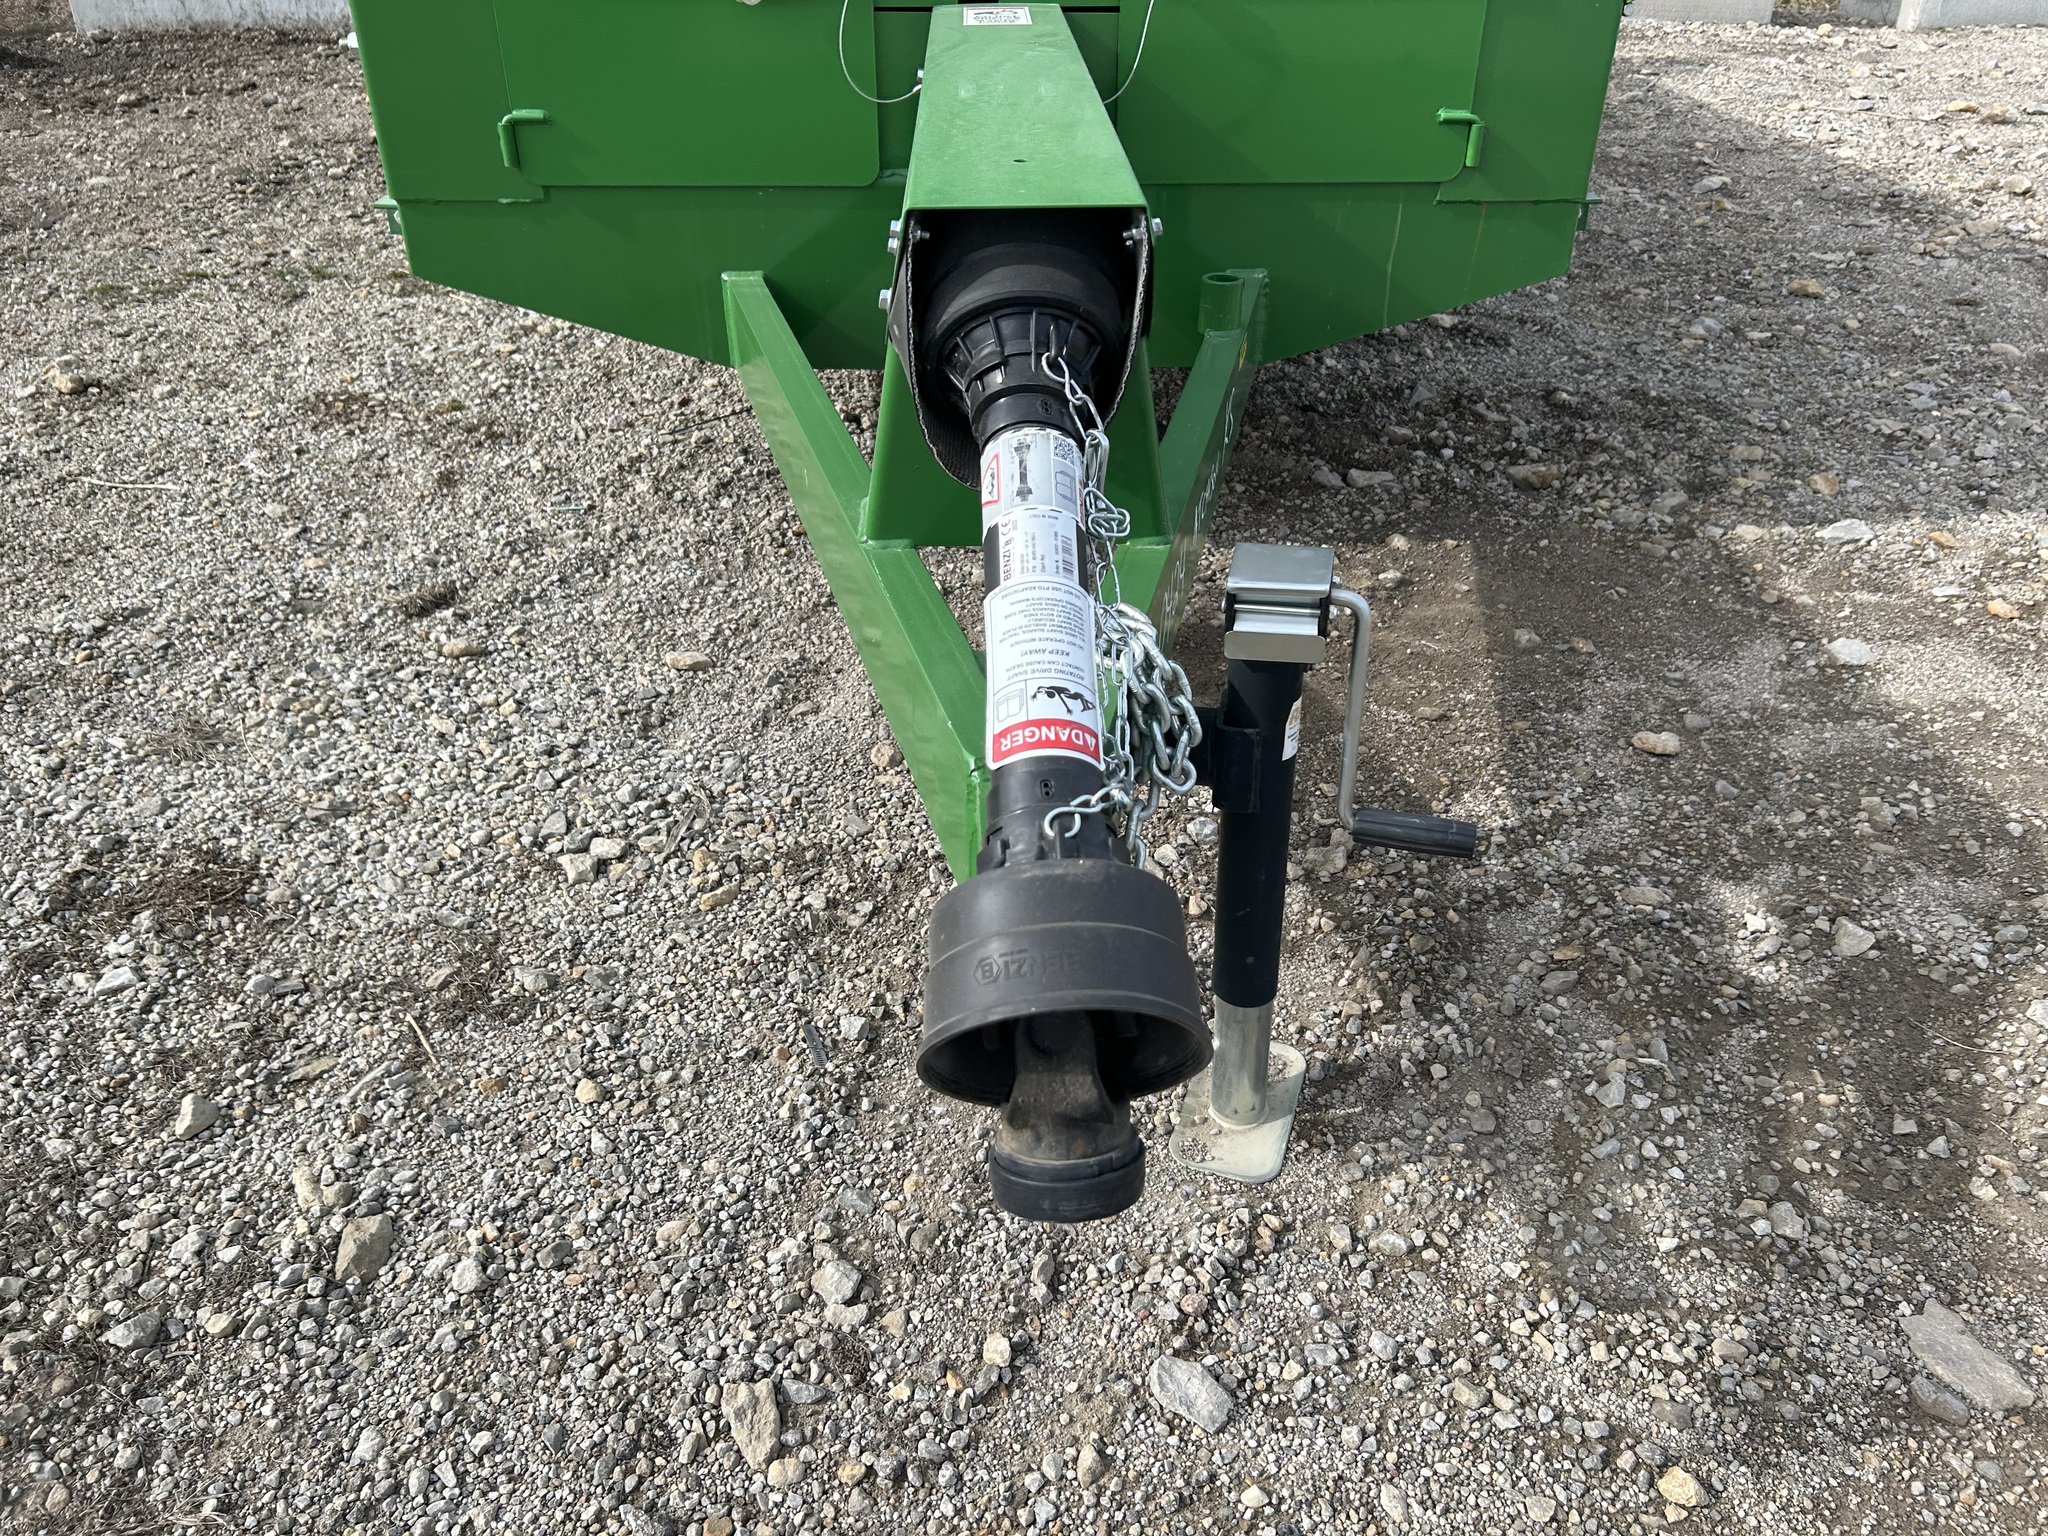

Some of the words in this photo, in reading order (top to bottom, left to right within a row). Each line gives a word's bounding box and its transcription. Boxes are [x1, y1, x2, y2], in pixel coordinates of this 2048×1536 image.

[1003, 549, 1012, 582] BENZI
[1063, 615, 1084, 627] ATTACHED
[1002, 627, 1017, 636] PLACE
[1049, 624, 1076, 633] EQUIPMENT
[999, 632, 1020, 644] TRACTOR
[1065, 631, 1078, 639] DRIVE
[1020, 648, 1047, 657] AWAY!
[1048, 649, 1070, 657] KEEP
[1006, 662, 1024, 673] DEATH
[1061, 662, 1085, 673] CONTACT
[1006, 669, 1028, 681] SHAFT
[1054, 668, 1085, 681] ROTATING
[1000, 726, 1084, 752] DANGER
